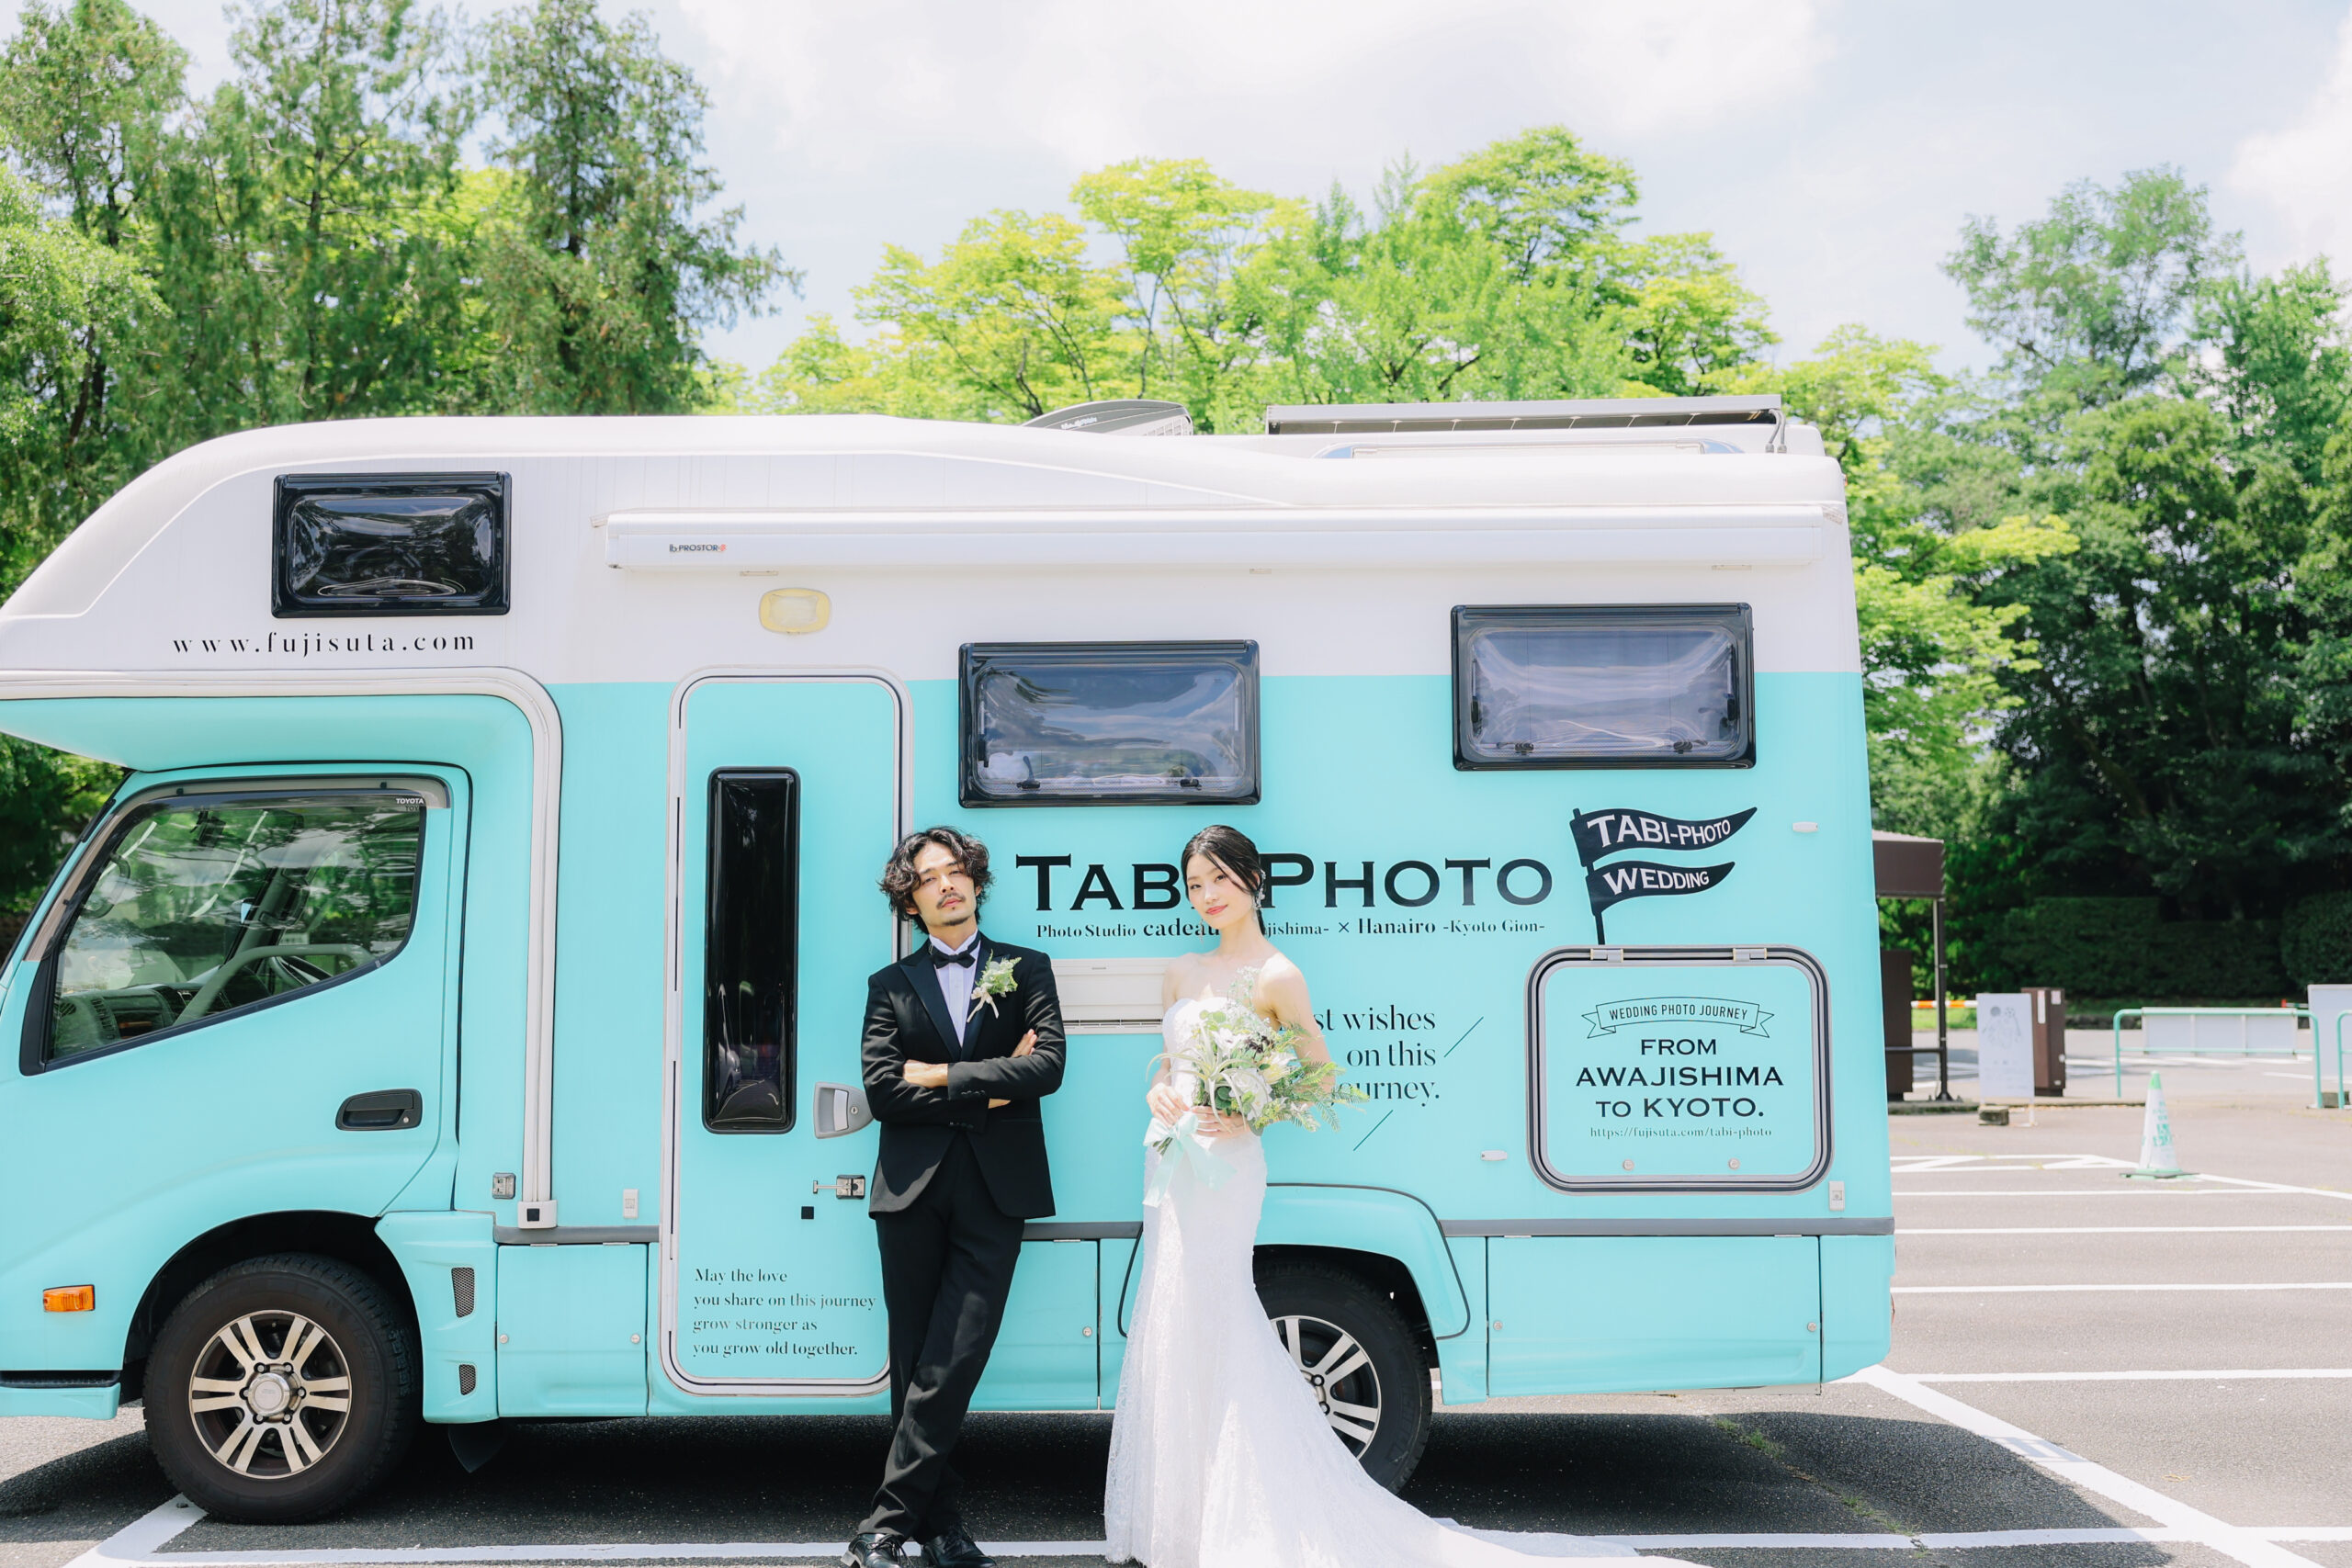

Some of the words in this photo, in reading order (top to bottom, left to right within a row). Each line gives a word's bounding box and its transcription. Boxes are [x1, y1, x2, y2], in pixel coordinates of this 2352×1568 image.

[173, 631, 475, 658] www.fujisuta.com
[1587, 814, 1731, 848] TABI-PHOTO
[1602, 867, 1710, 897] WEDDING
[1037, 924, 1082, 938] Photo
[1084, 923, 1136, 937] Studio
[1143, 918, 1220, 937] cadeau
[1264, 921, 1329, 939] jishima-
[1358, 918, 1436, 934] Hanairo
[1442, 919, 1497, 937] -Kyoto
[1501, 919, 1545, 932] Gion-
[1342, 1004, 1436, 1031] wishes
[1609, 1005, 1657, 1021] WEDDING
[1661, 1003, 1696, 1016] PHOTO
[1699, 1004, 1748, 1021] JOURNEY
[1346, 1048, 1380, 1067] on
[1387, 1040, 1436, 1066] this
[1642, 1039, 1716, 1055] FROM
[1576, 1066, 1783, 1086] AWAJISHIMA
[1596, 1101, 1631, 1117] TO
[1644, 1098, 1763, 1117] KYOTO.
[1590, 1126, 1772, 1140] https://fujisuta.com/tabi-photo
[695, 1268, 726, 1286] May
[731, 1268, 754, 1282] the
[758, 1268, 787, 1282] love
[694, 1296, 720, 1309] you
[724, 1292, 764, 1306] share
[768, 1296, 786, 1306] on
[790, 1292, 817, 1306] this
[820, 1293, 876, 1311] journey
[693, 1320, 731, 1334] grow
[735, 1318, 798, 1334] stronger
[801, 1321, 818, 1331] as
[693, 1344, 719, 1357] you
[722, 1345, 761, 1359] grow
[765, 1340, 788, 1355] old
[793, 1341, 858, 1359] together.
